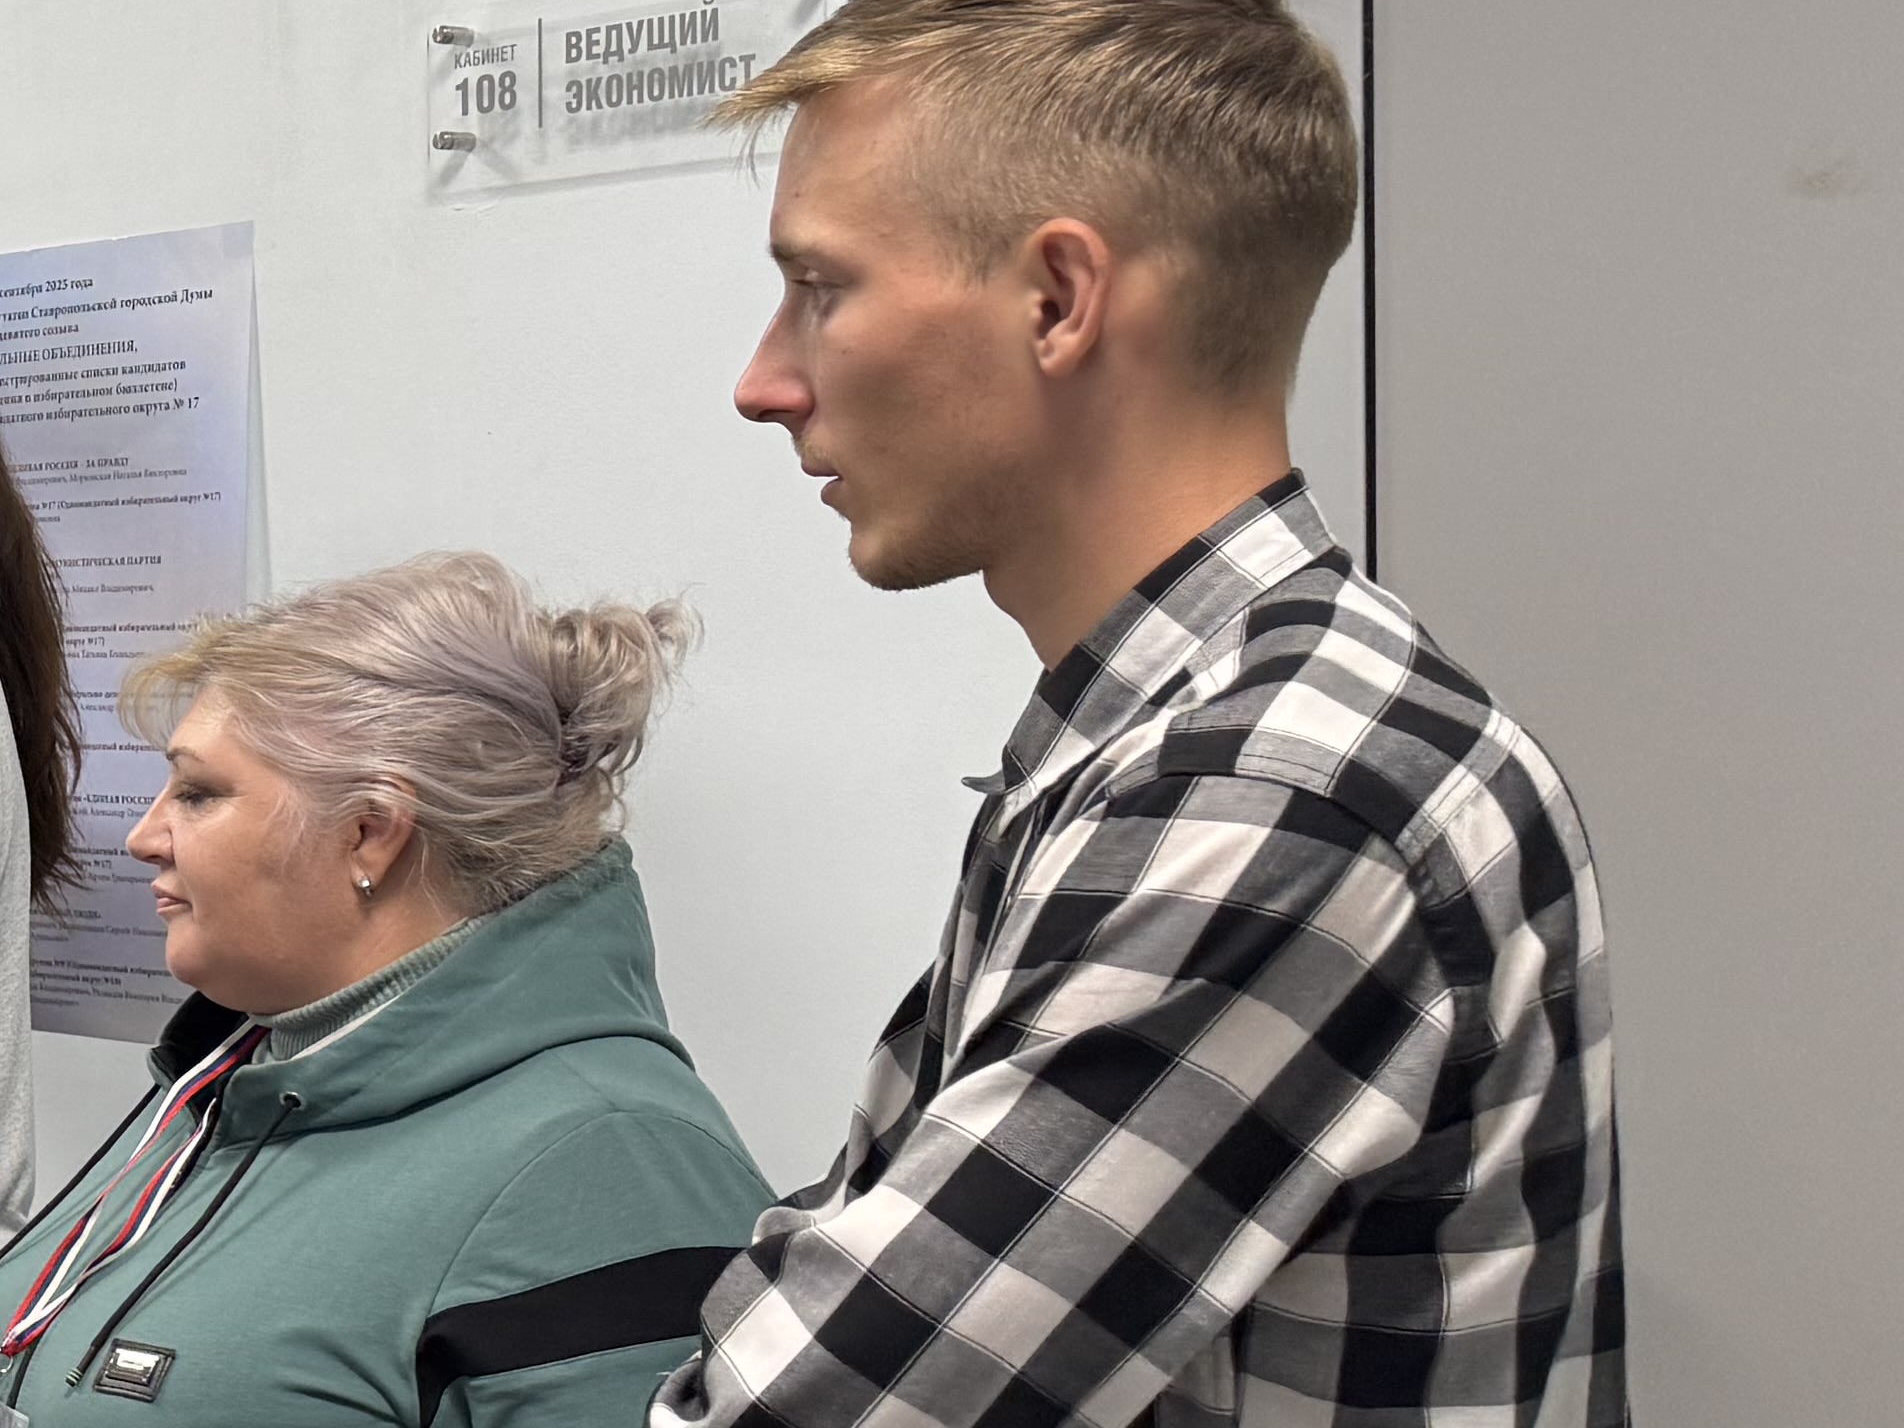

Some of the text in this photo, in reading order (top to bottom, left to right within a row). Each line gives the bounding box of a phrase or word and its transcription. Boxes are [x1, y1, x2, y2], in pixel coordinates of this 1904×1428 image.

[454, 44, 517, 69] КАБИНЕТ
[456, 70, 517, 116] 108
[565, 54, 756, 114] ЭКОНОМИСТ
[70, 279, 93, 290] года
[31, 298, 117, 319] Ставропольской
[120, 294, 178, 309] городской
[180, 288, 213, 304] Думы
[42, 323, 79, 337] созыва
[42, 340, 138, 360] ОБЪЕДИНЕНИЯ,
[81, 366, 119, 379] списки
[122, 361, 186, 374] кандидатов
[33, 388, 113, 406] избирательном
[116, 379, 177, 396] бюллетене)
[46, 405, 131, 422] избирательного
[133, 402, 170, 416] округа
[187, 397, 199, 409] 17
